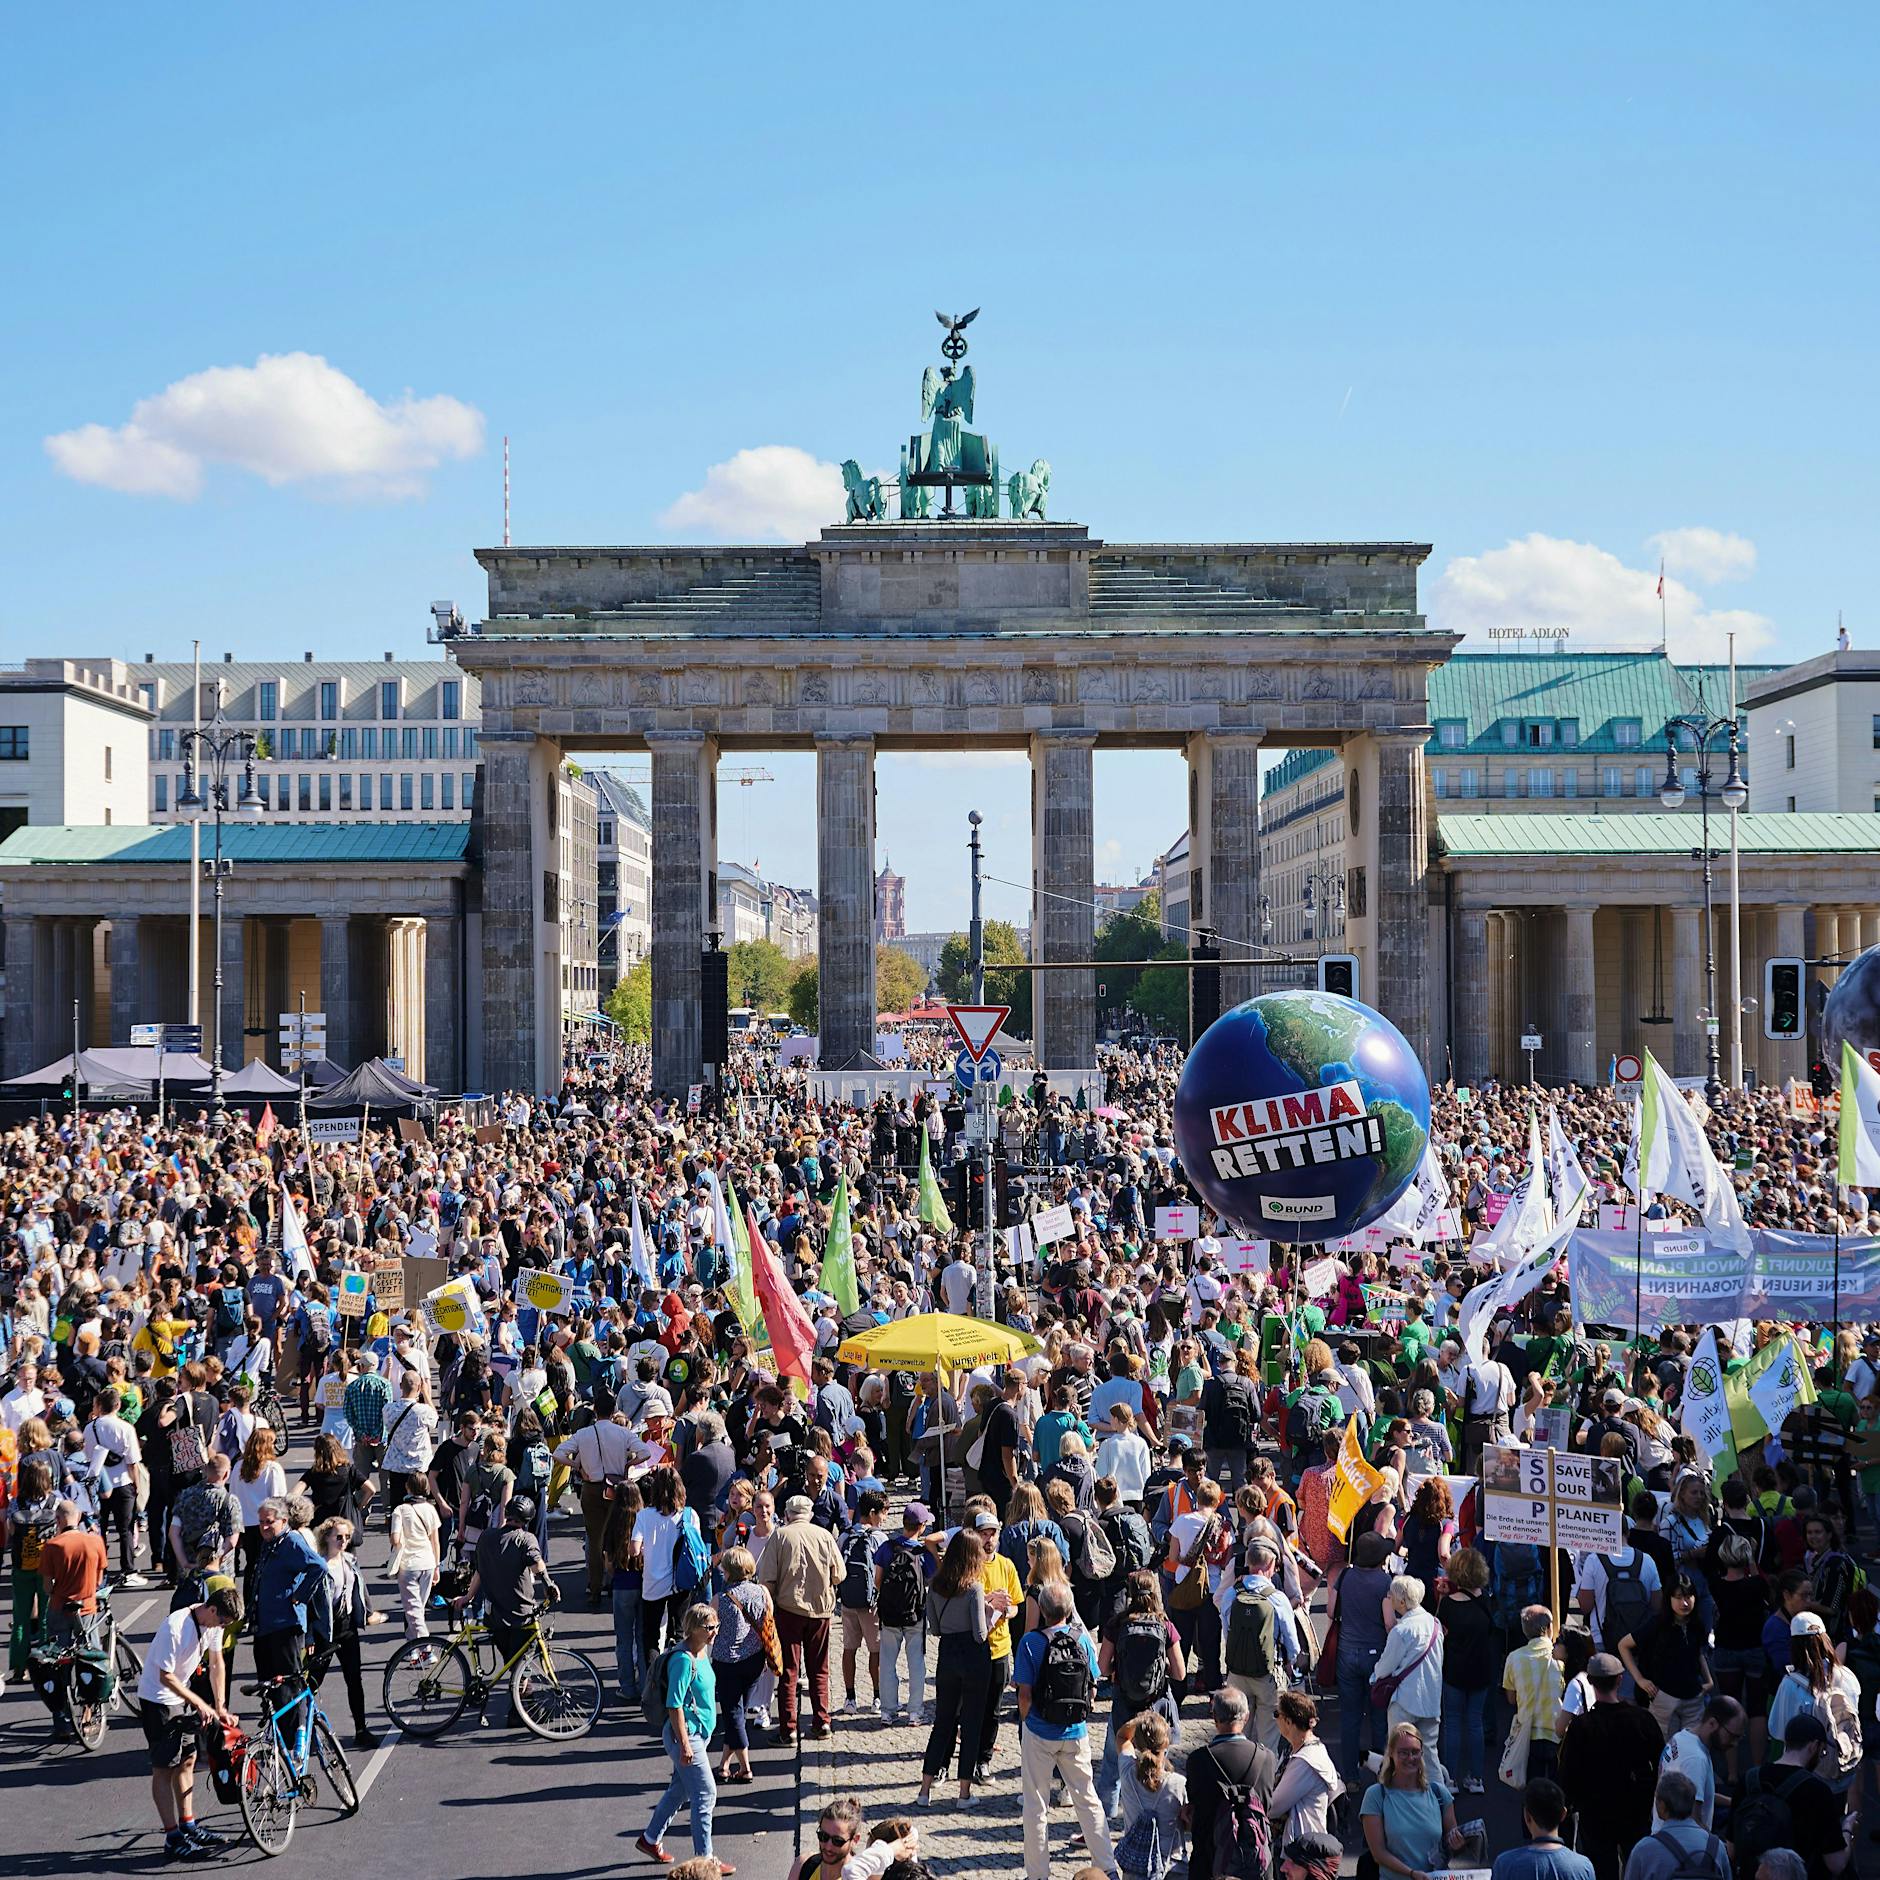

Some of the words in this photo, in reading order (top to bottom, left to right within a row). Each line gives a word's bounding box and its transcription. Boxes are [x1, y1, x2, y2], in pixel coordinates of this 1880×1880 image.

[1488, 628, 1526, 638] HOTEL
[1530, 628, 1570, 638] ADLON
[1216, 1086, 1360, 1142] KLIMA
[313, 1122, 356, 1132] SPENDEN
[1211, 1118, 1382, 1180] RETTEN!
[1286, 1205, 1323, 1213] BUND
[520, 1270, 540, 1281] KLIMA
[518, 1286, 538, 1297] JETZT!
[520, 1278, 569, 1296] GERECHTIGKEIT
[422, 1300, 440, 1309] KLIMA
[424, 1303, 468, 1317] GERECHTIGKEIT
[428, 1314, 446, 1325] JETZT!
[880, 1358, 926, 1366] www.jungewelt.de
[1530, 1459, 1544, 1475] S
[1556, 1465, 1590, 1479] SAVE
[1530, 1478, 1546, 1494] O
[1557, 1483, 1586, 1496] OUR
[1532, 1502, 1545, 1518] P
[1557, 1508, 1610, 1524] PLANET
[1512, 1526, 1542, 1534] dennoch
[1558, 1523, 1616, 1536] Lebensgrundlage
[1558, 1532, 1590, 1540] zerstören
